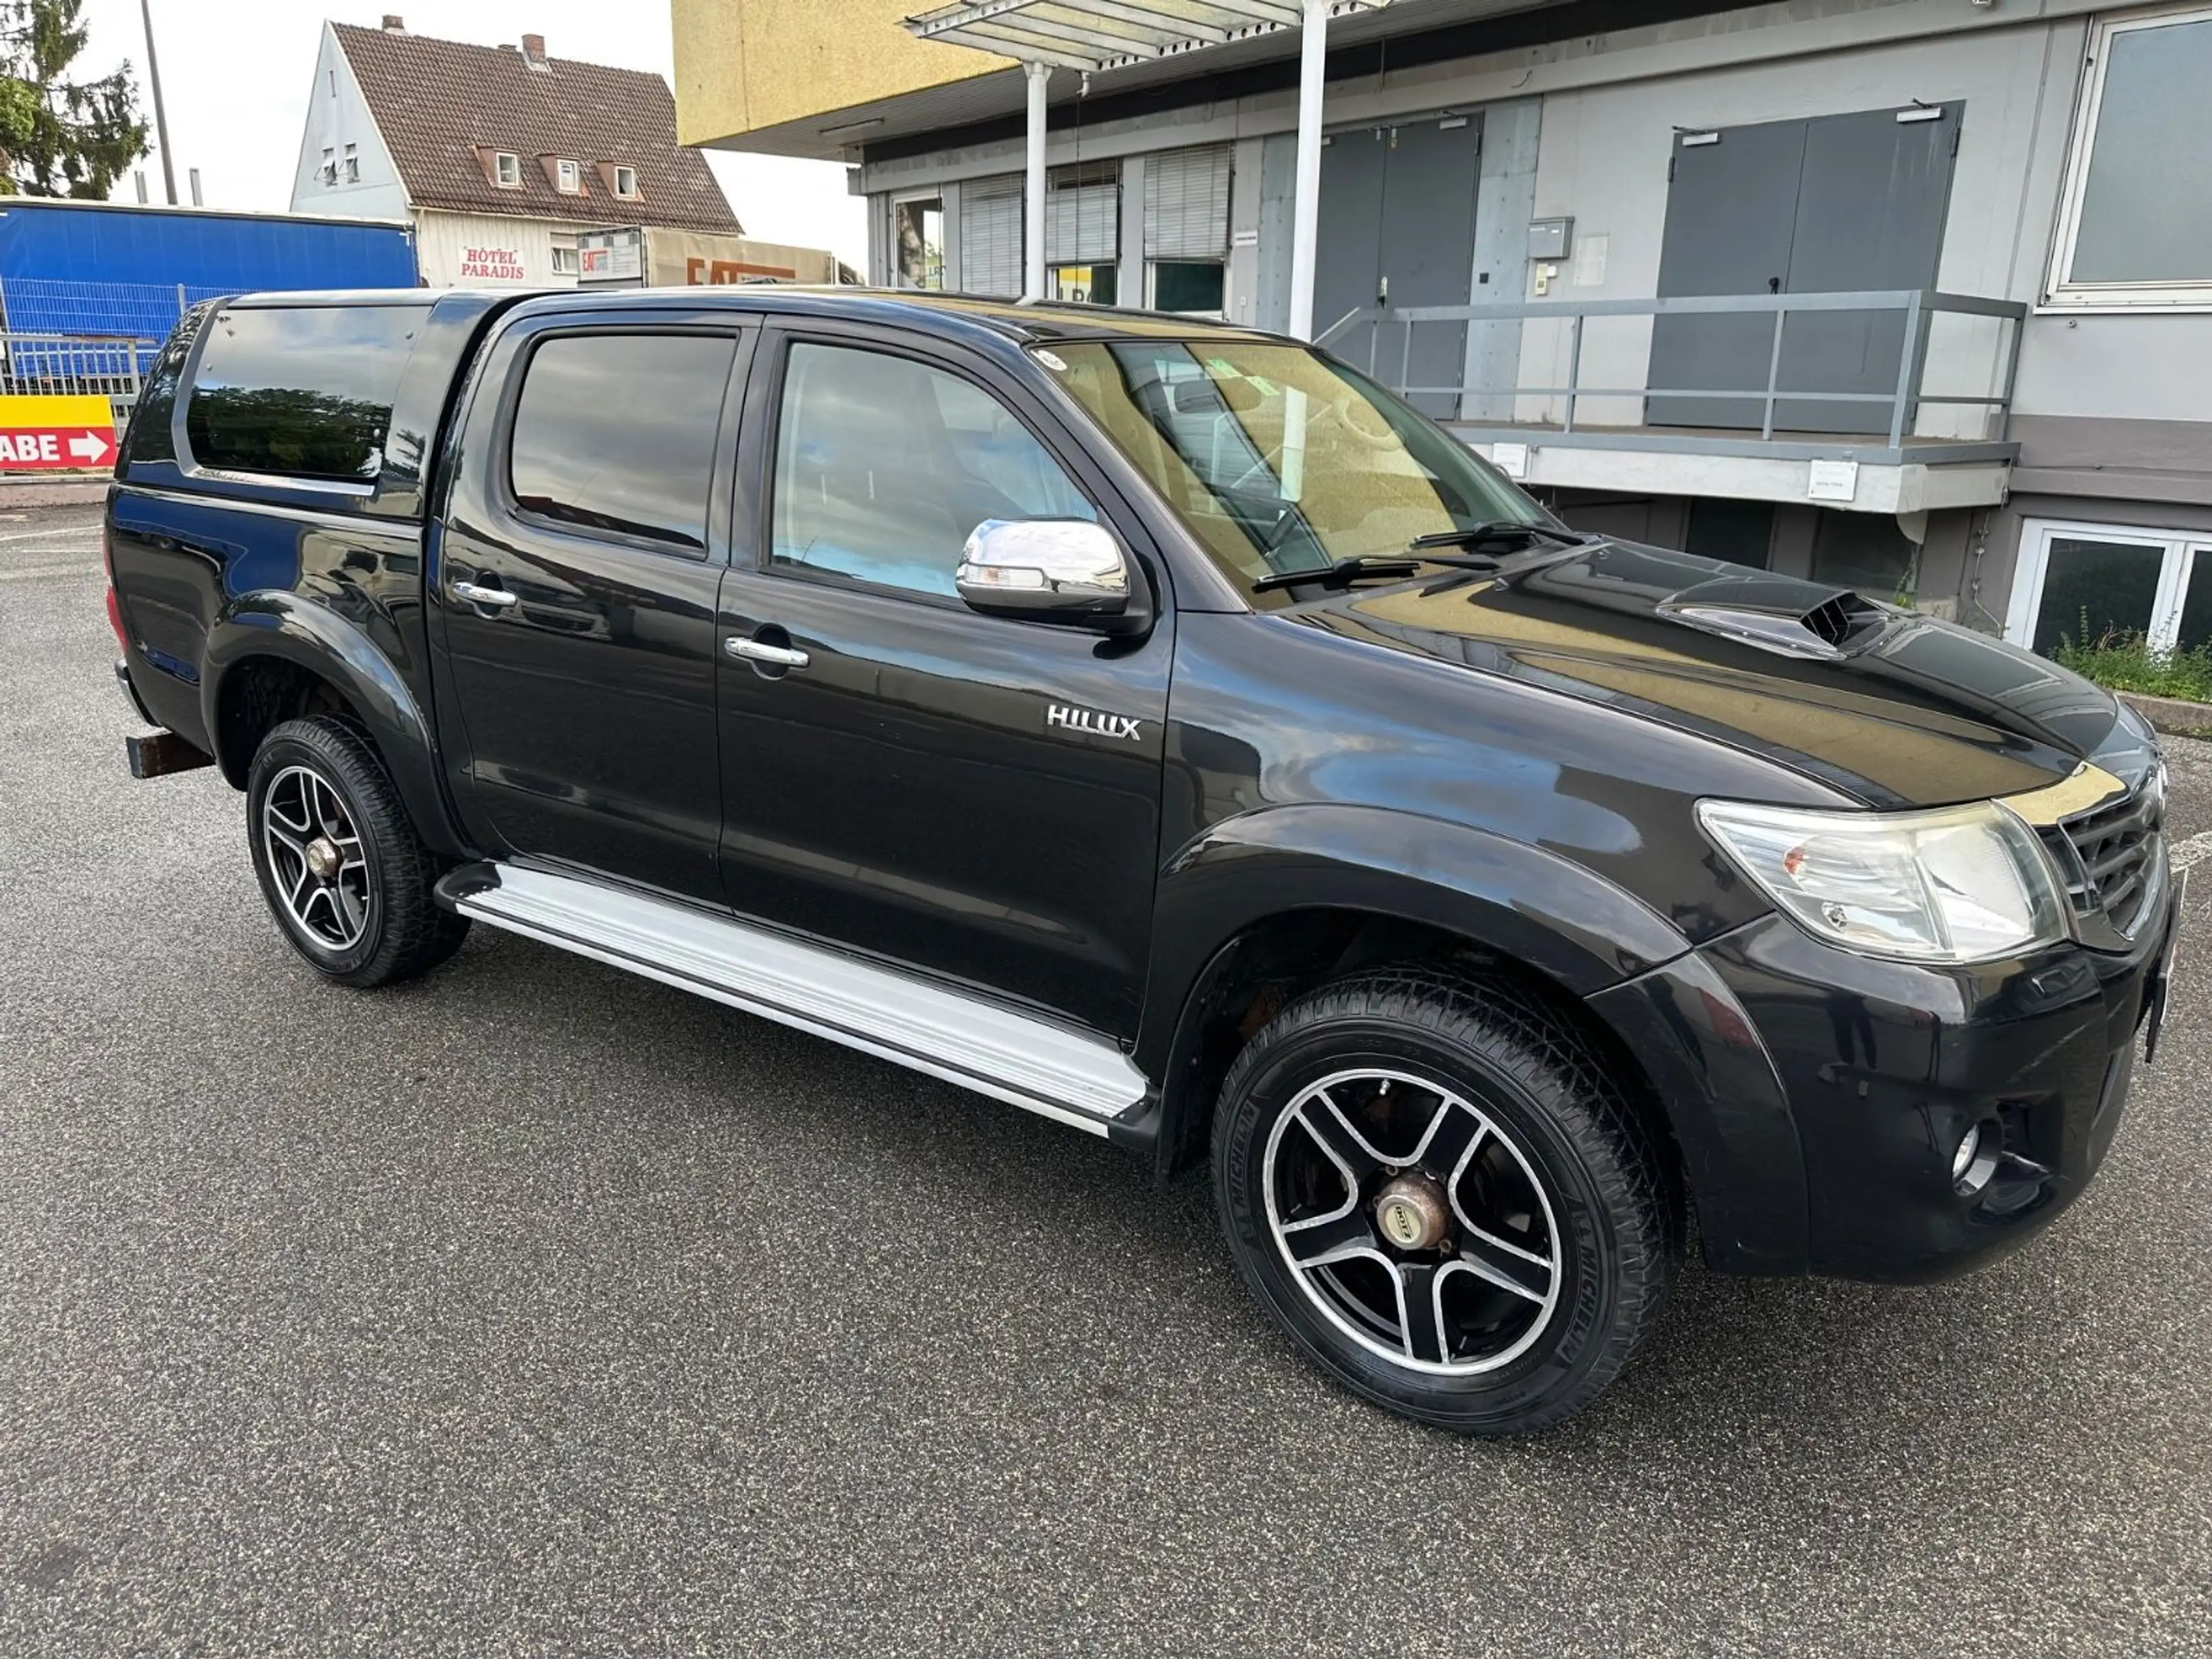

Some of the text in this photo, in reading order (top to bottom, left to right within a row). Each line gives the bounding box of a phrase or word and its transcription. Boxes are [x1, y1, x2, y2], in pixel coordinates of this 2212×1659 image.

[461, 263, 524, 279] PARADIS
[0, 435, 60, 461] ABE
[1047, 704, 1142, 741] HILUX
[1230, 1099, 1260, 1209] MICHELIN
[1395, 1206, 1411, 1238] DOTZ
[1555, 1242, 1599, 1363] MICHELIN
